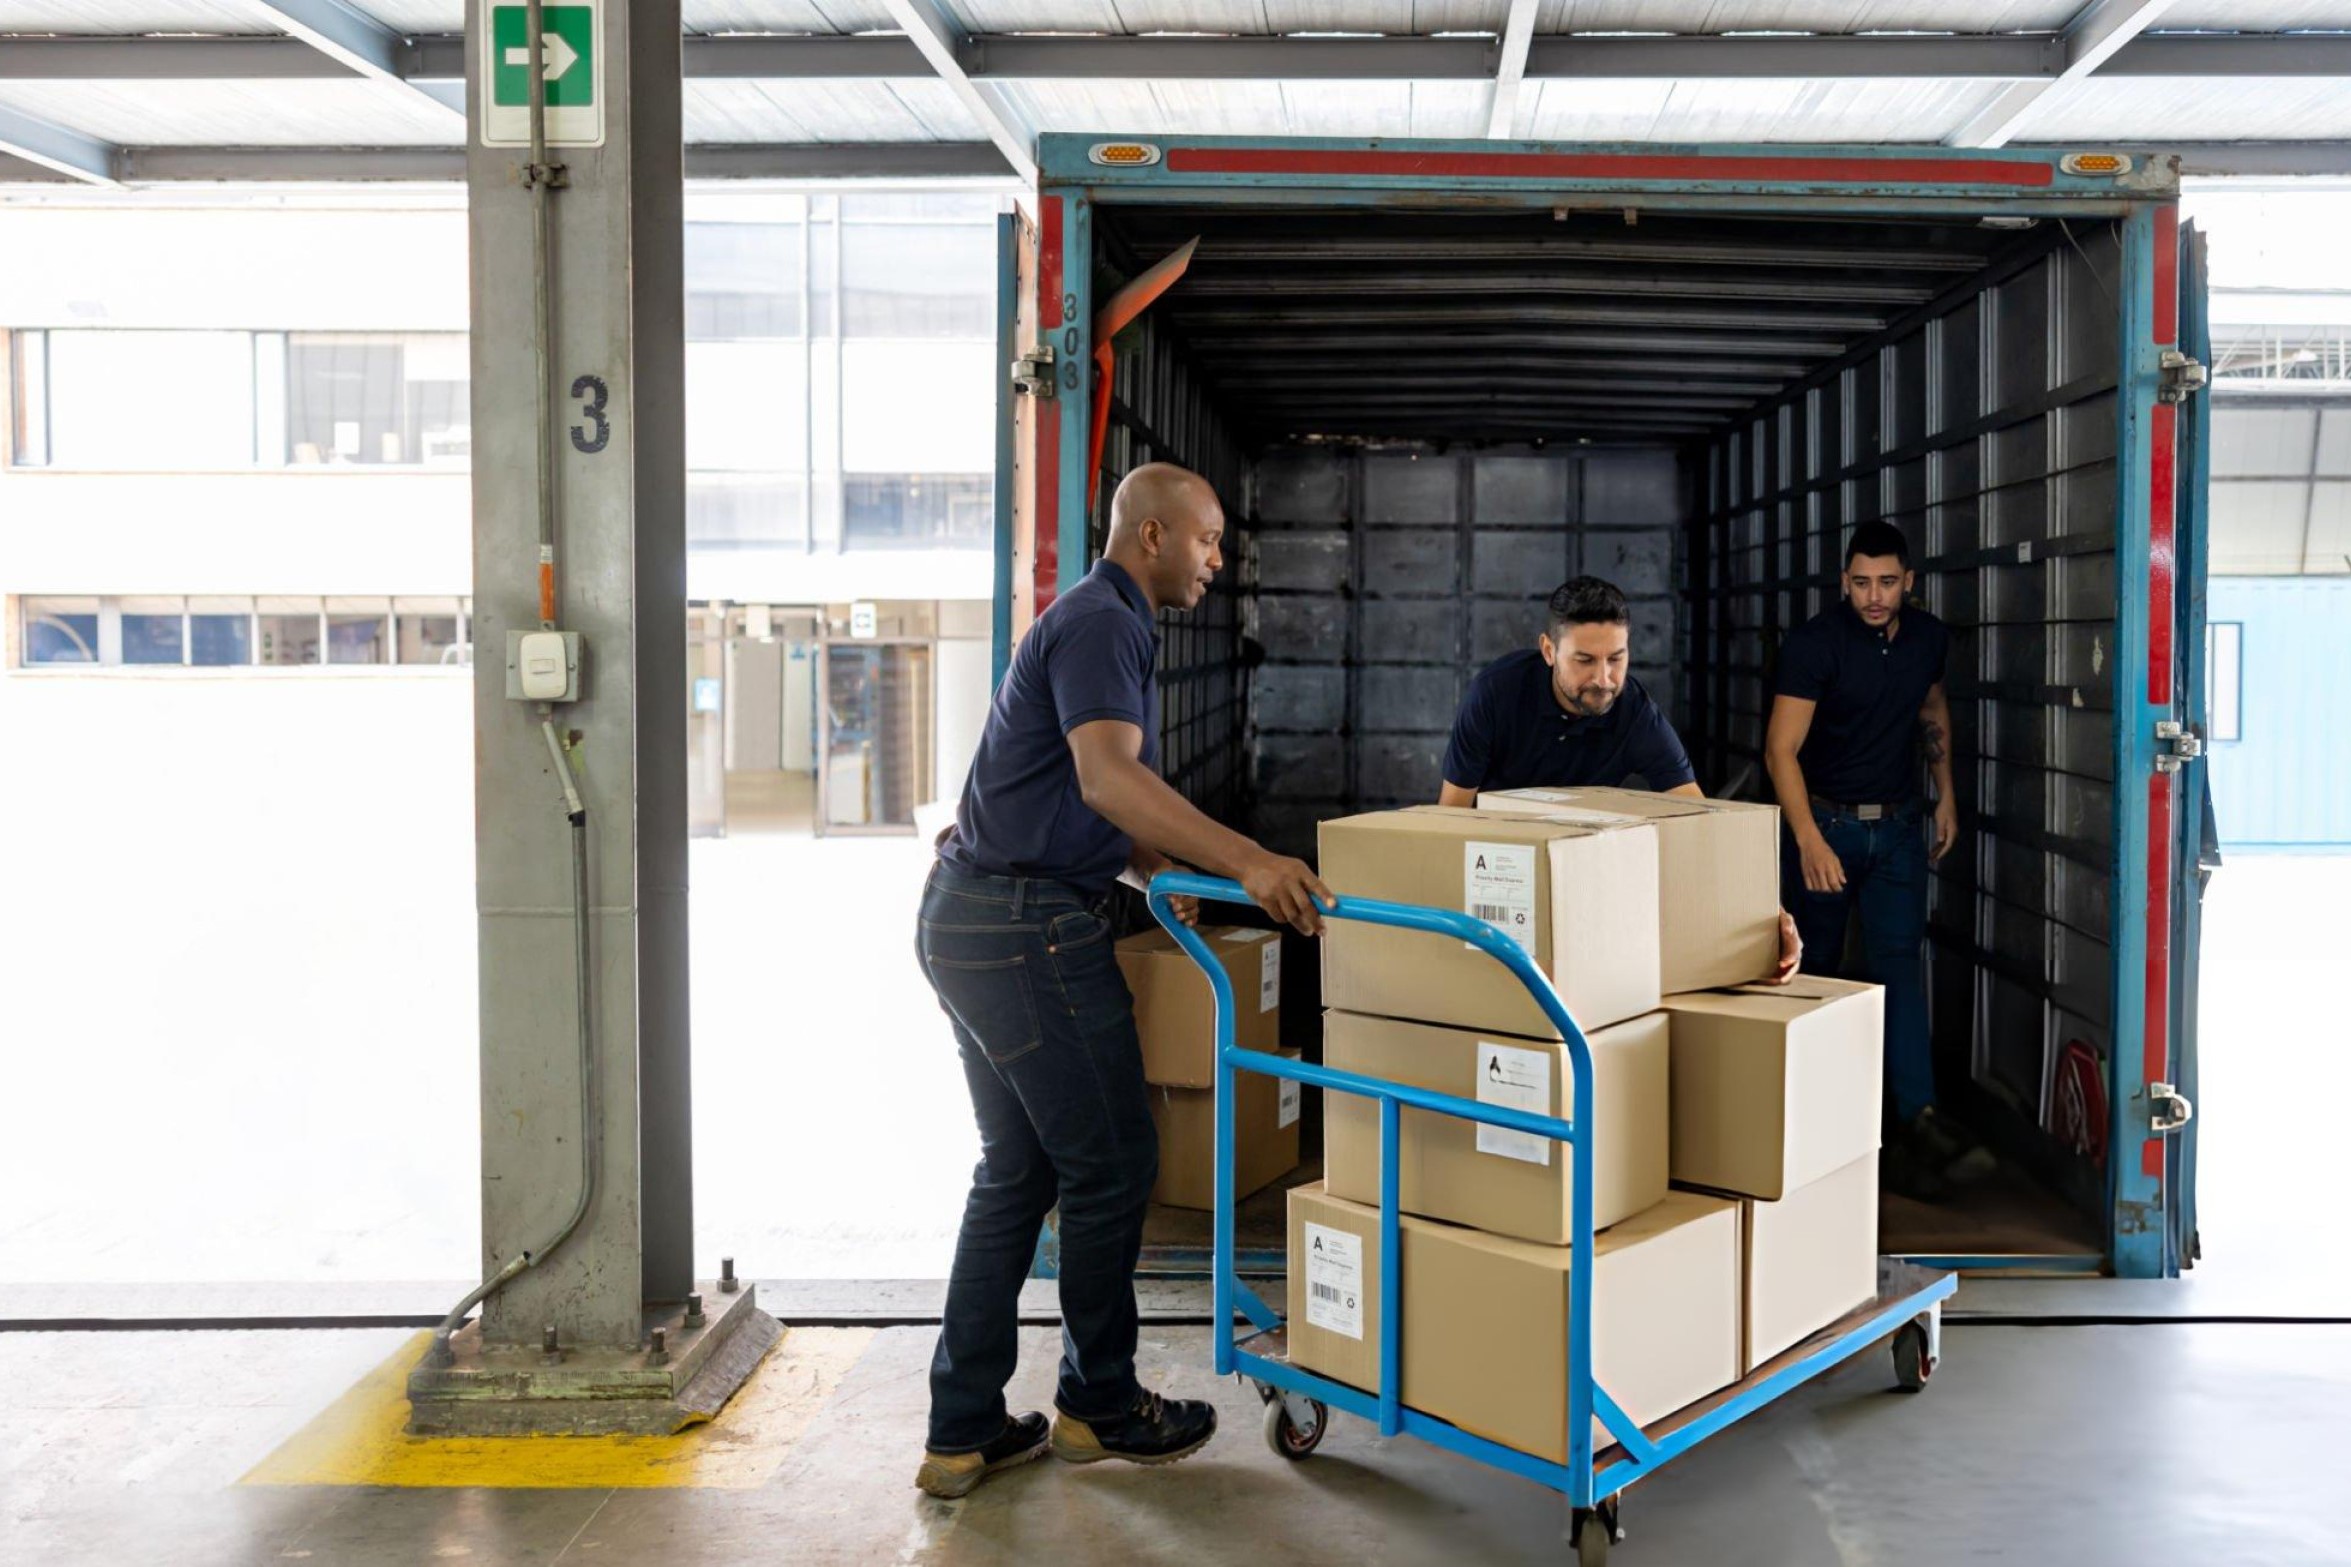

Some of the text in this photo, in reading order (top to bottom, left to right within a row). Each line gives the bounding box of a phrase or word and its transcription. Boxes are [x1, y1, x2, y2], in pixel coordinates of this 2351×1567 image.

[1063, 292, 1079, 391] 303
[570, 374, 610, 454] 3
[1475, 854, 1487, 870] A
[1313, 1235, 1323, 1252] A
